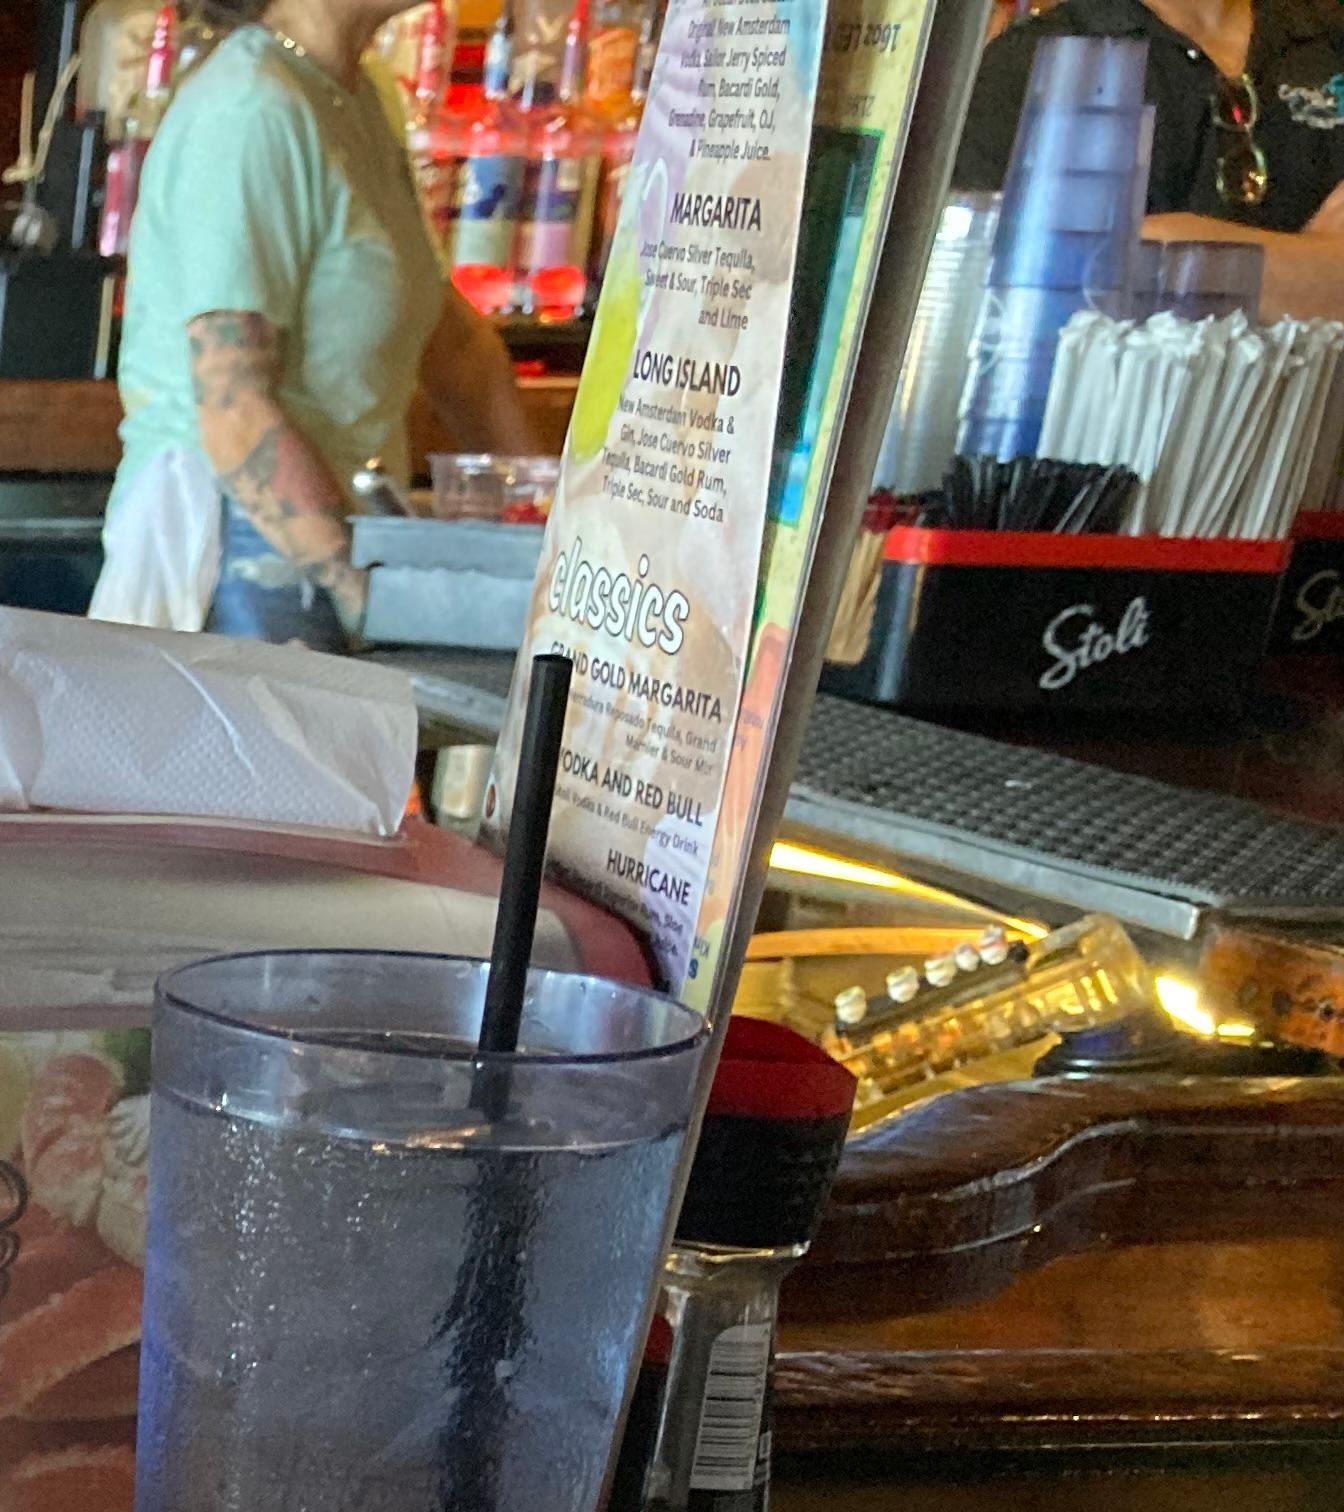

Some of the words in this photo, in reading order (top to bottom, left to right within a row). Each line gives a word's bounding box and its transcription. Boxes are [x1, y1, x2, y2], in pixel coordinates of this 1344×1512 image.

[735, 15, 790, 36] Amsterdam
[726, 46, 751, 73] Jerry
[752, 46, 787, 73] Spiced
[718, 78, 753, 98] Bacardi
[754, 77, 780, 103] Gold,
[708, 108, 757, 135] Grapefruit,
[759, 109, 775, 134] OJ,
[697, 138, 739, 164] Pineapple
[670, 192, 761, 231] MARGARITA
[658, 240, 686, 261] Cuervo
[687, 244, 712, 264] Silver
[714, 247, 755, 274] Tequila,
[676, 272, 698, 297] Sour,
[700, 275, 730, 301] Triple
[731, 279, 752, 300] Sec
[698, 308, 718, 327] and
[720, 308, 748, 329] Lime
[633, 349, 673, 386] LONG
[675, 357, 741, 397] ISLAND
[619, 392, 634, 413] New
[636, 397, 686, 427] Amsterdam
[688, 408, 724, 432] Vodka
[726, 415, 734, 434] &
[637, 426, 658, 449] Jose
[659, 432, 695, 458] Cuervo
[697, 439, 731, 464] Silver
[633, 455, 667, 480] Bacardi
[669, 464, 694, 487] Gold
[697, 470, 727, 498] Rum,
[602, 475, 626, 500] Triple
[646, 488, 668, 510] Sour
[670, 495, 691, 515] and
[693, 499, 724, 523] Soda
[549, 535, 690, 656] classics
[1039, 595, 1154, 690] Stoli
[590, 656, 626, 689] GOLD
[628, 671, 722, 722] MARGARITA
[670, 750, 693, 771] Sour
[561, 748, 599, 785] ODKA
[601, 767, 632, 797] AND
[635, 779, 664, 809] RED
[666, 791, 703, 826] BULL
[640, 817, 671, 847] Energy
[672, 833, 698, 855] Drink
[607, 848, 691, 906] HURRICANE
